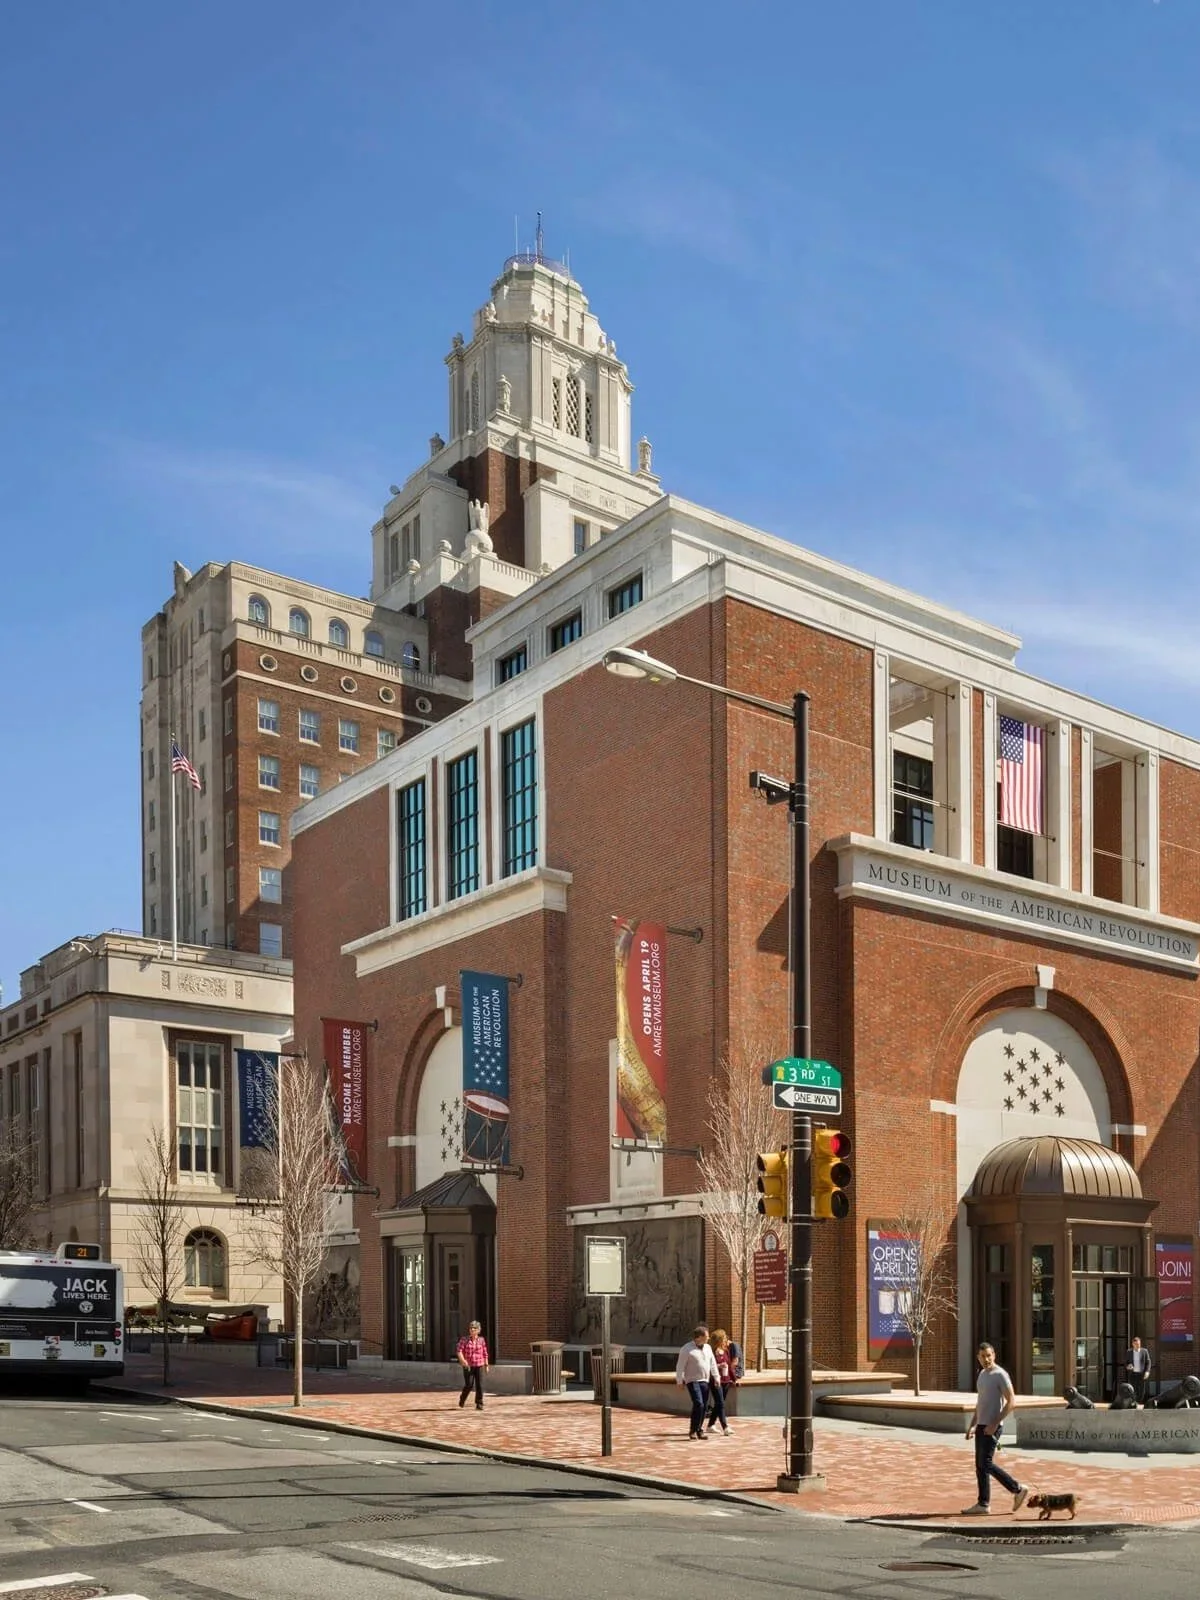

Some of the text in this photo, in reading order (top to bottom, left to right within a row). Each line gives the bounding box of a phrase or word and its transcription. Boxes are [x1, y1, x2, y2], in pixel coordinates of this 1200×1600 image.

[868, 863, 1193, 955] MUSEUM OF THE AMERICAN REVOLUTION
[640, 940, 652, 1035] OPENS APRIL 19
[651, 942, 662, 1057] AMREVMUSEUM.ORG
[473, 1006, 481, 1045] MUSEUM
[482, 995, 492, 1047] AMERICAN
[491, 989, 502, 1048] REVOLUTION
[343, 1027, 352, 1124] BECOME A MEMBER
[352, 1029, 361, 1125] AMREVMUSEUM.ORG
[821, 1076, 831, 1086] ST
[794, 1092, 833, 1105] ONE WAY
[77, 1248, 88, 1257] 21
[873, 1246, 917, 1261] OPENS
[873, 1262, 917, 1274] APRIL 19
[1158, 1261, 1192, 1277] JOIN!
[62, 1278, 108, 1293] JACK
[63, 1292, 85, 1300] LIVES
[1029, 1430, 1085, 1440] MUSEUM
[1132, 1429, 1199, 1440] AMERICAN
